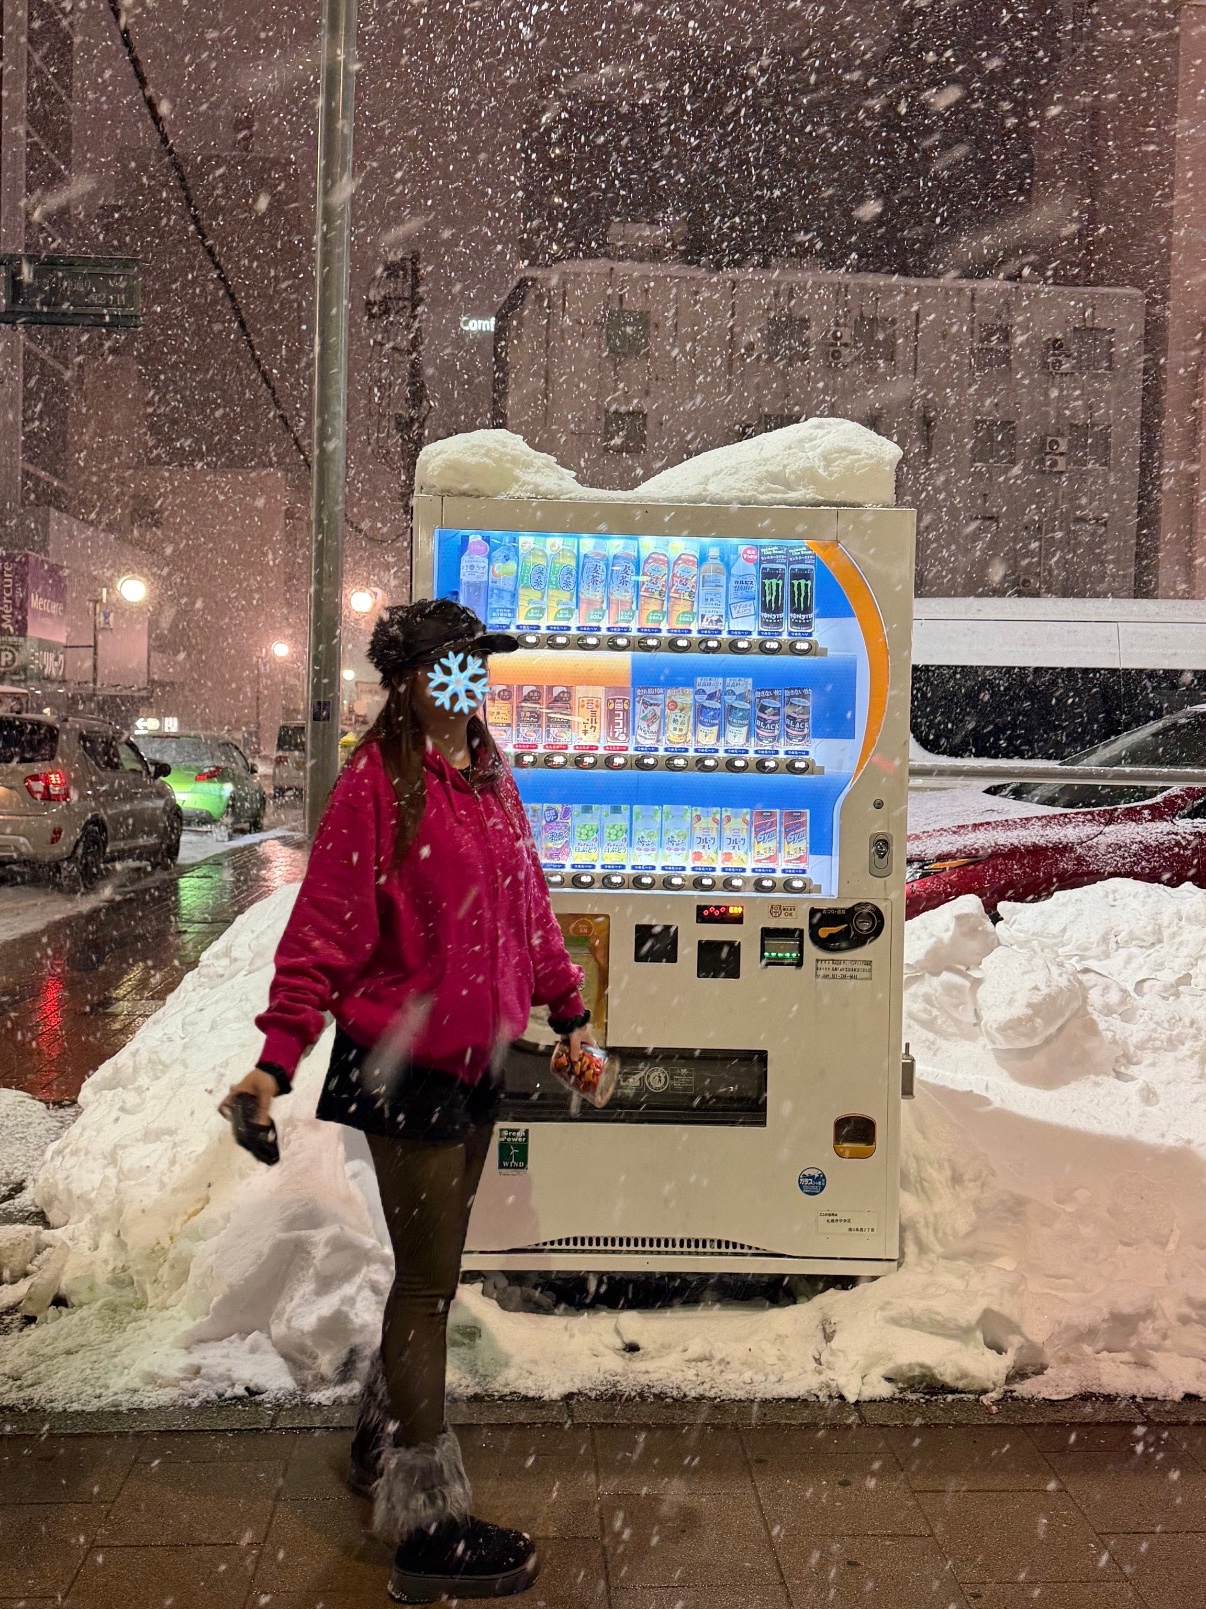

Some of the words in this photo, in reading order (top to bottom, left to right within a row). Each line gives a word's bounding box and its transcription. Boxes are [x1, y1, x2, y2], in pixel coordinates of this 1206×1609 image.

[591, 563, 601, 586] 麦茶
[619, 564, 631, 587] 麦茶
[1, 561, 14, 635] Mercure
[30, 591, 64, 616] Mercure
[1, 651, 13, 667] P
[590, 709, 598, 733] ミルク
[614, 710, 625, 738] ココア
[756, 719, 780, 731] BLACK
[785, 719, 809, 730] BLACK
[695, 836, 716, 845] フルーツ
[725, 837, 746, 846] フルーツ
[756, 829, 777, 844] Gym
[786, 830, 806, 845] Gym
